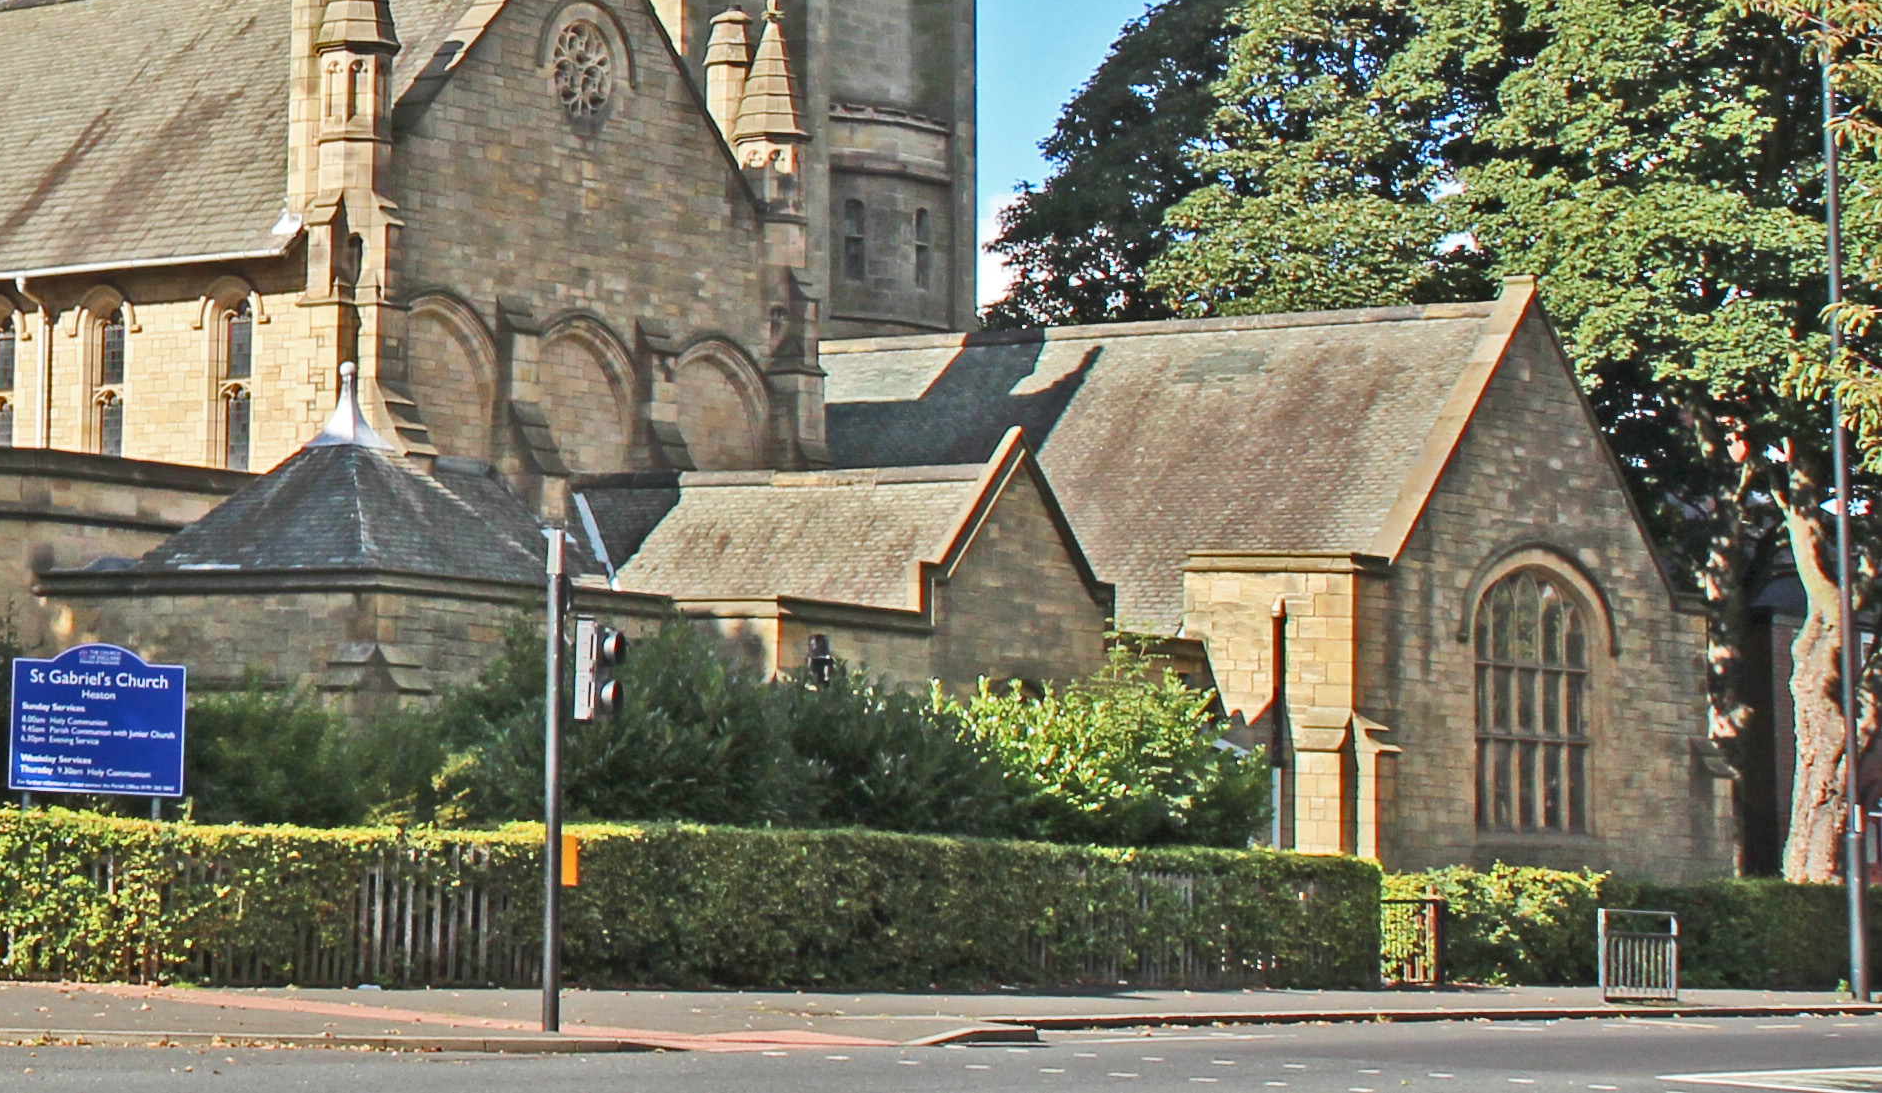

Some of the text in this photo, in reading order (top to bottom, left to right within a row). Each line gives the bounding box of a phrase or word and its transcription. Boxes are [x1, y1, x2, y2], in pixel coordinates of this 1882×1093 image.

[30, 668, 169, 689] St Gabriel's Church
[81, 689, 116, 700] Heaton
[21, 701, 86, 713] Sunday Services
[49, 716, 65, 726] Holy
[67, 717, 108, 727] Communion
[49, 725, 69, 735] Parish
[71, 727, 111, 736] Communion
[150, 729, 176, 739] Church
[49, 735, 74, 746] Evening
[75, 736, 100, 746] Service
[58, 755, 92, 765] Services
[19, 763, 54, 776] Thursday
[87, 767, 104, 778] Holy
[106, 768, 151, 778] Communion
